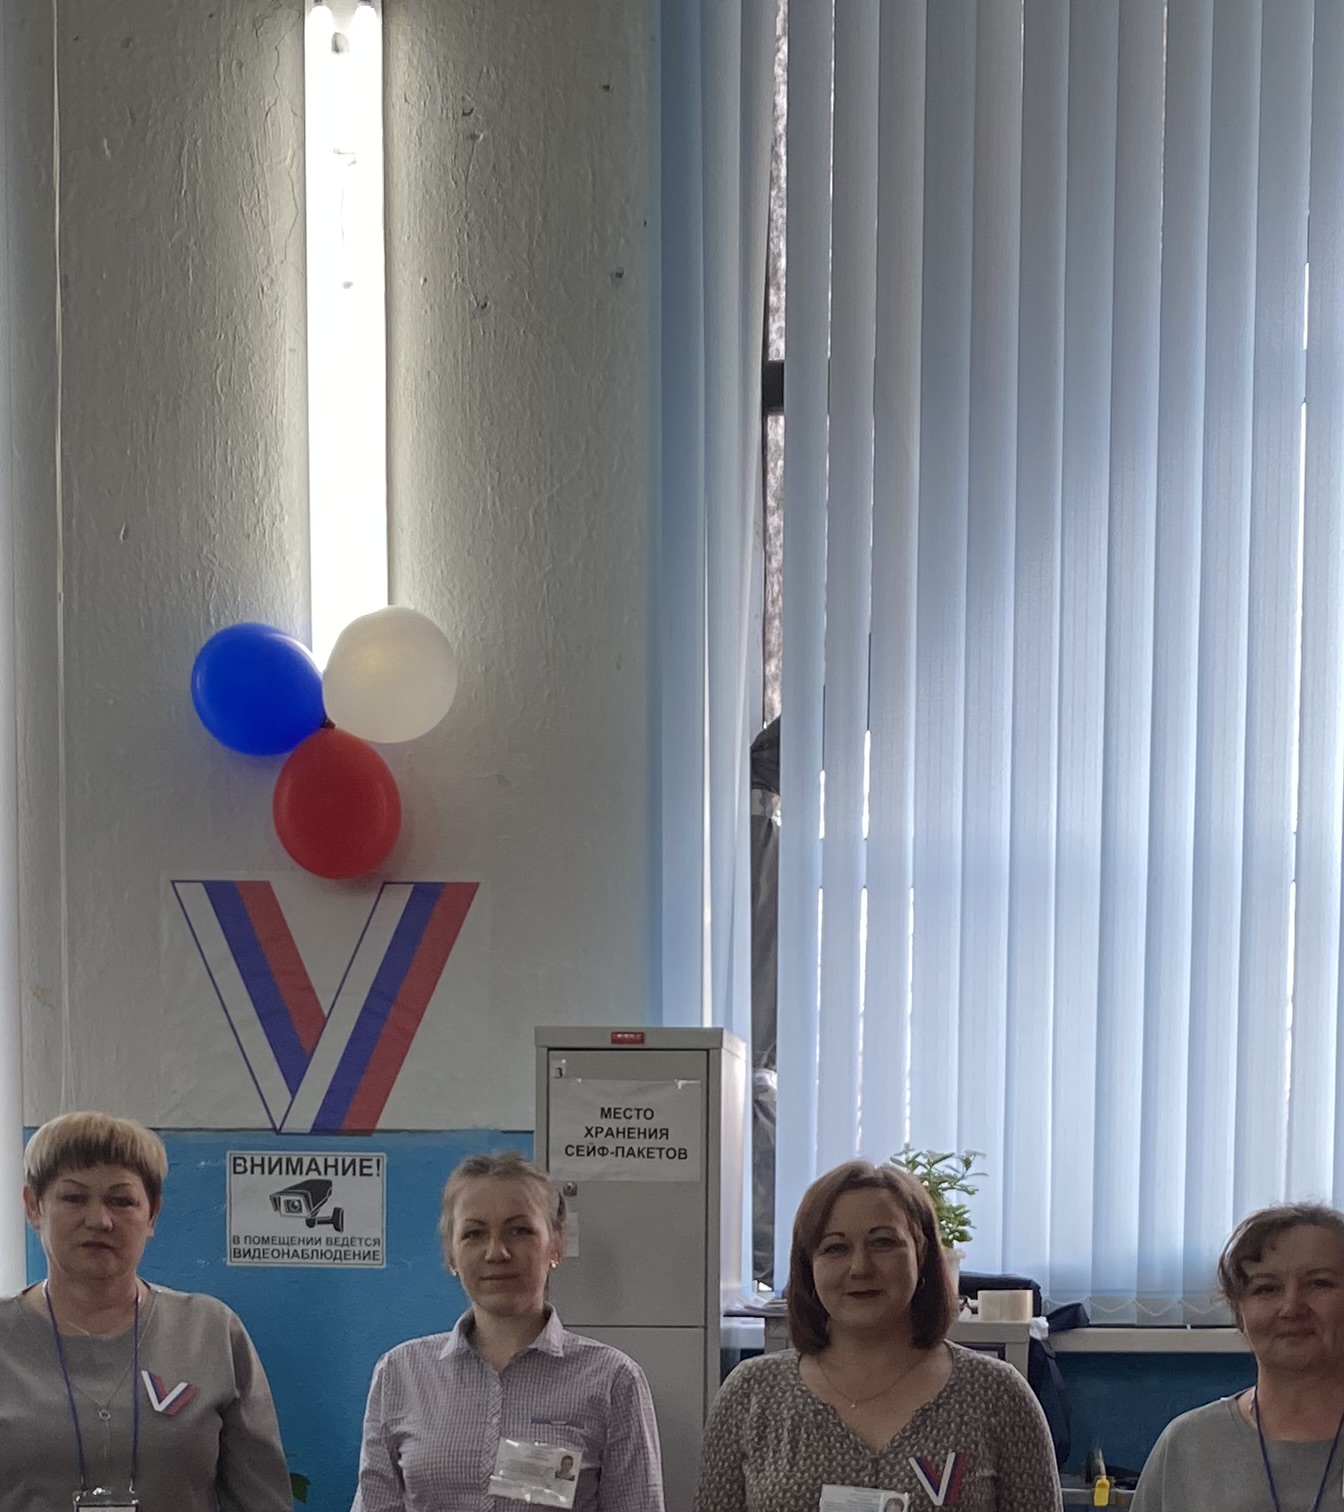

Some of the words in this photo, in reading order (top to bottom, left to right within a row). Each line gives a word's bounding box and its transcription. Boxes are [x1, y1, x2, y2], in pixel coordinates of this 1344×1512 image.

[600, 1107, 655, 1121] МЕСТО
[584, 1125, 670, 1141] ХРАНЕНИЯ
[564, 1142, 689, 1161] СЕЙФ-ПАКЕТОВ
[232, 1156, 381, 1177] ВНИМАНИЕ!
[232, 1235, 241, 1245] В
[244, 1235, 322, 1248] ПОМЕЩЕНИИ
[325, 1235, 381, 1248] ВЕДЁТСЯ
[232, 1247, 381, 1262] ВИДЕОНАБЛЮДЕНИЕ
